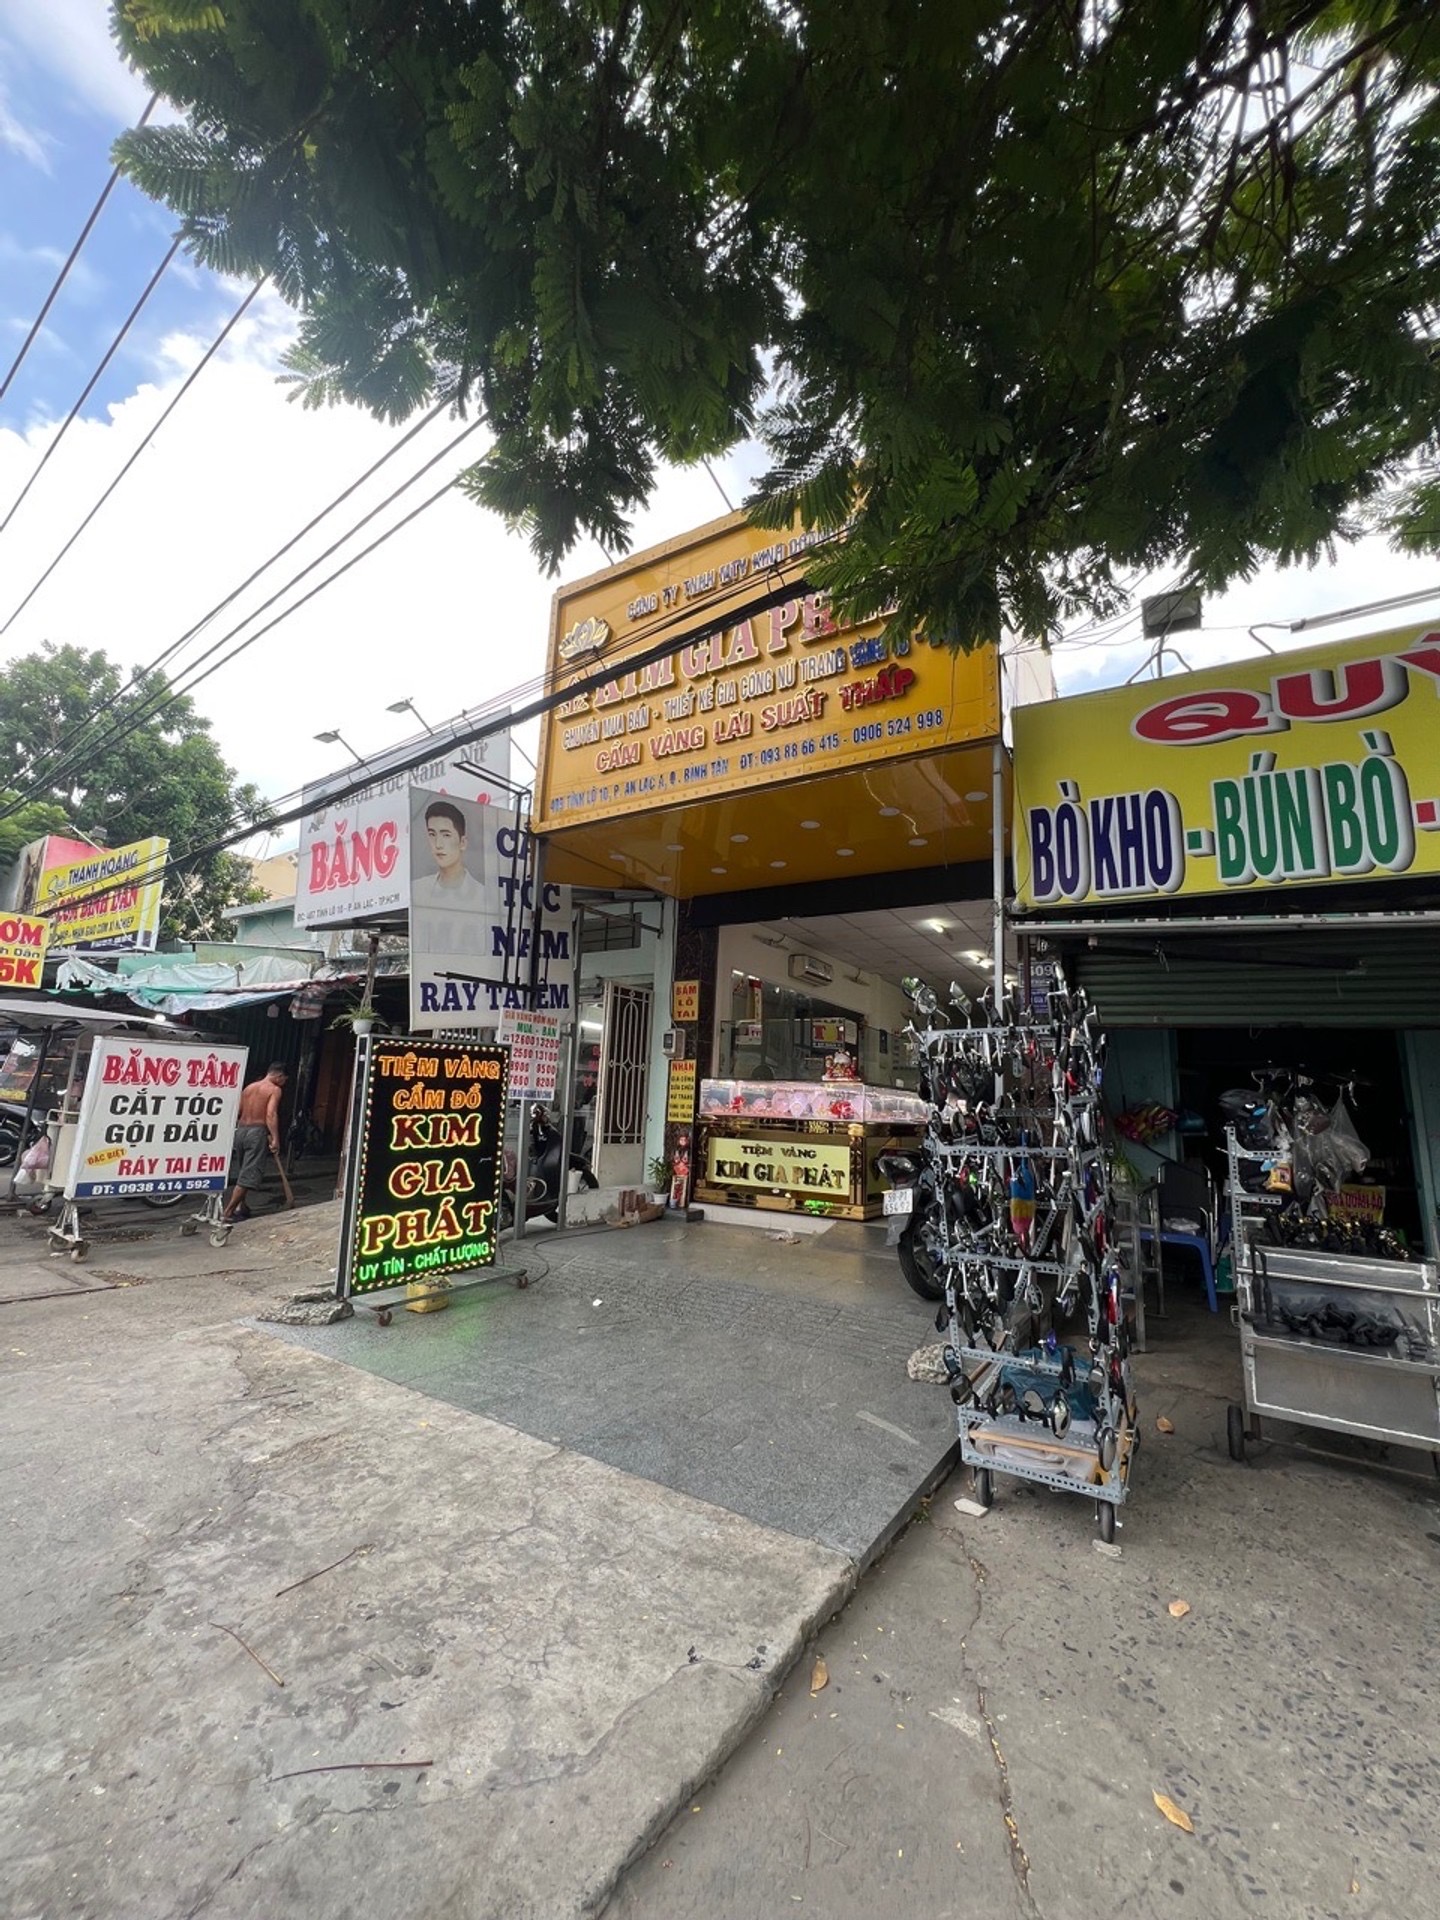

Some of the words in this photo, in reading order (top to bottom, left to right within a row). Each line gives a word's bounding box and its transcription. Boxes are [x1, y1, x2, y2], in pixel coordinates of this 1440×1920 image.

[681, 619, 759, 679] GIA
[563, 717, 599, 750] CHUYÊN
[601, 713, 624, 740] MUA
[628, 702, 649, 732] BÁN
[664, 684, 696, 721] THIẾT
[716, 683, 736, 708] GIA
[741, 668, 774, 700] CÔNG
[800, 647, 846, 683] TRANG
[650, 725, 706, 760] VÀNG
[713, 707, 752, 744] LÃI
[760, 685, 827, 732] SUẤT
[838, 663, 917, 712] THẤP
[624, 781, 637, 797] AN
[684, 763, 707, 782] BÌNH
[711, 756, 729, 777] TÂN
[760, 747, 781, 765] 093
[784, 742, 798, 760] 88
[802, 739, 816, 756] 66
[819, 733, 839, 752] 415
[853, 722, 882, 745] 0906
[888, 717, 911, 738] 524
[917, 709, 944, 730] 998
[1029, 780, 1084, 899] BÒ
[1089, 789, 1179, 895] KHO
[1212, 752, 1326, 883] BÚN
[1324, 730, 1411, 873] BÒ
[69, 864, 98, 885] THANH
[99, 850, 139, 878] HOÀNG
[309, 819, 399, 894] BĂNG
[516, 1022, 533, 1034] MUA
[677, 1010, 695, 1018] TAI
[102, 1047, 182, 1087] BĂNG
[187, 1053, 241, 1088] TÂM
[379, 1052, 439, 1080] TIỆM
[444, 1054, 501, 1080] VÀNG
[672, 1062, 694, 1074] NHẬN
[109, 1087, 166, 1116] CẮT
[175, 1093, 223, 1116] TÓC
[105, 1120, 155, 1147] GỘI
[163, 1118, 218, 1143] ĐẦU
[390, 1113, 482, 1151] KIM
[118, 1155, 159, 1176] RÁY
[165, 1156, 192, 1175] TAI
[197, 1153, 226, 1173] ÊM
[741, 1143, 773, 1158] TIỆM
[780, 1146, 817, 1159] VÀNG
[92, 1184, 114, 1196] ĐT:
[118, 1181, 154, 1194] 0938
[157, 1179, 182, 1192] 414
[186, 1178, 211, 1190] 592
[388, 1158, 475, 1199] GIA
[715, 1159, 749, 1180] KIM
[754, 1162, 788, 1183] GIA
[792, 1162, 846, 1190] PHÁT
[361, 1197, 492, 1256] PHÁT
[359, 1263, 379, 1281] UY
[383, 1256, 404, 1276] TÍN
[414, 1246, 448, 1269] CHẤT
[450, 1242, 489, 1262] LƯỢNG
